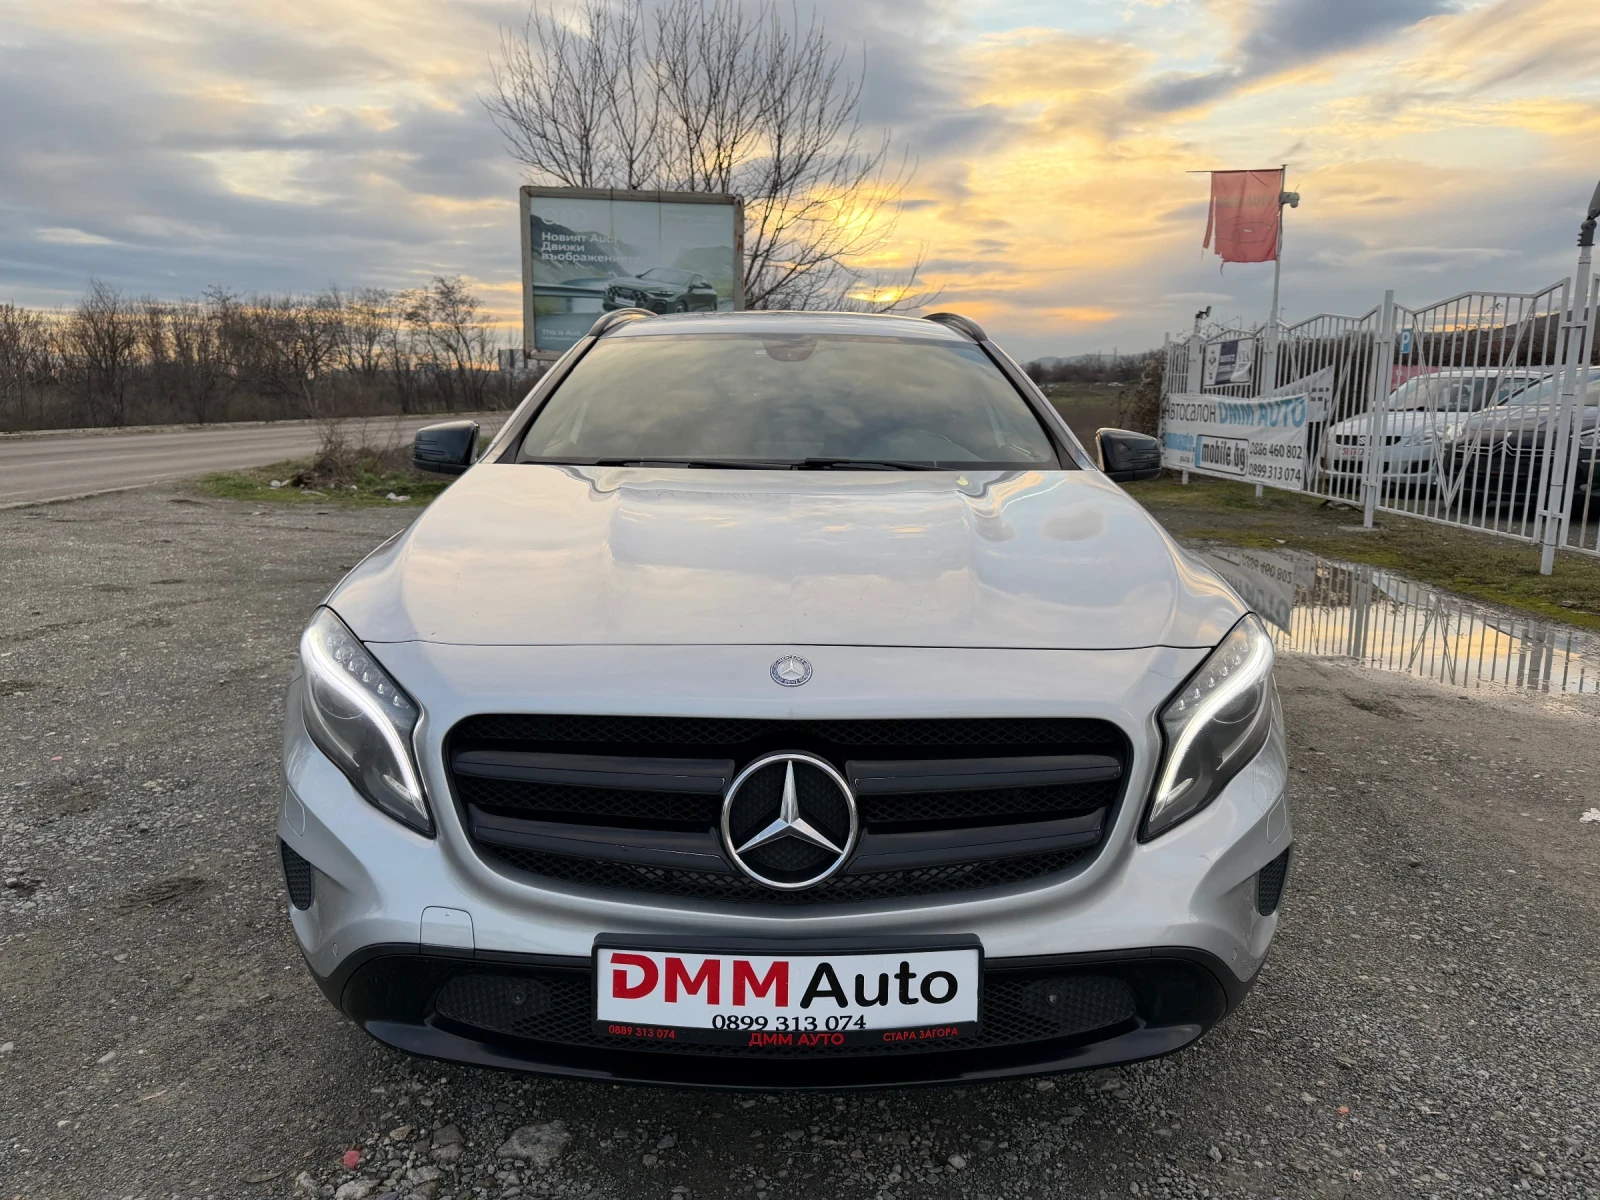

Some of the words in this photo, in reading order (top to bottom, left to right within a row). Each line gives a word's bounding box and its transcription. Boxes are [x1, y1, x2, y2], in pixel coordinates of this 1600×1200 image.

[541, 232, 587, 242] Новият
[541, 242, 585, 252] Движи
[1402, 331, 1411, 351] P
[1164, 397, 1217, 424] Автосалон
[1218, 402, 1254, 426] DMM
[1257, 397, 1306, 428] AUTO
[1202, 440, 1246, 472] mobile.bg
[1249, 442, 1267, 456] 0886
[1269, 443, 1285, 458] 460
[1286, 444, 1303, 459] 802
[1248, 462, 1267, 477] 0899
[1267, 465, 1283, 480] 313
[1284, 467, 1302, 482] 074
[610, 952, 789, 1007] DMM
[800, 961, 958, 1009] Auto
[608, 1024, 633, 1036] 0889
[635, 1027, 655, 1037] 313
[656, 1028, 676, 1039] 074
[711, 1014, 769, 1031] 0899
[776, 1015, 818, 1032] 313
[825, 1014, 867, 1031] 074
[749, 1032, 793, 1047] ДММ
[797, 1032, 844, 1046] АУТО
[882, 1031, 917, 1042] СТАРА
[919, 1026, 959, 1040] ЗАГОРА
